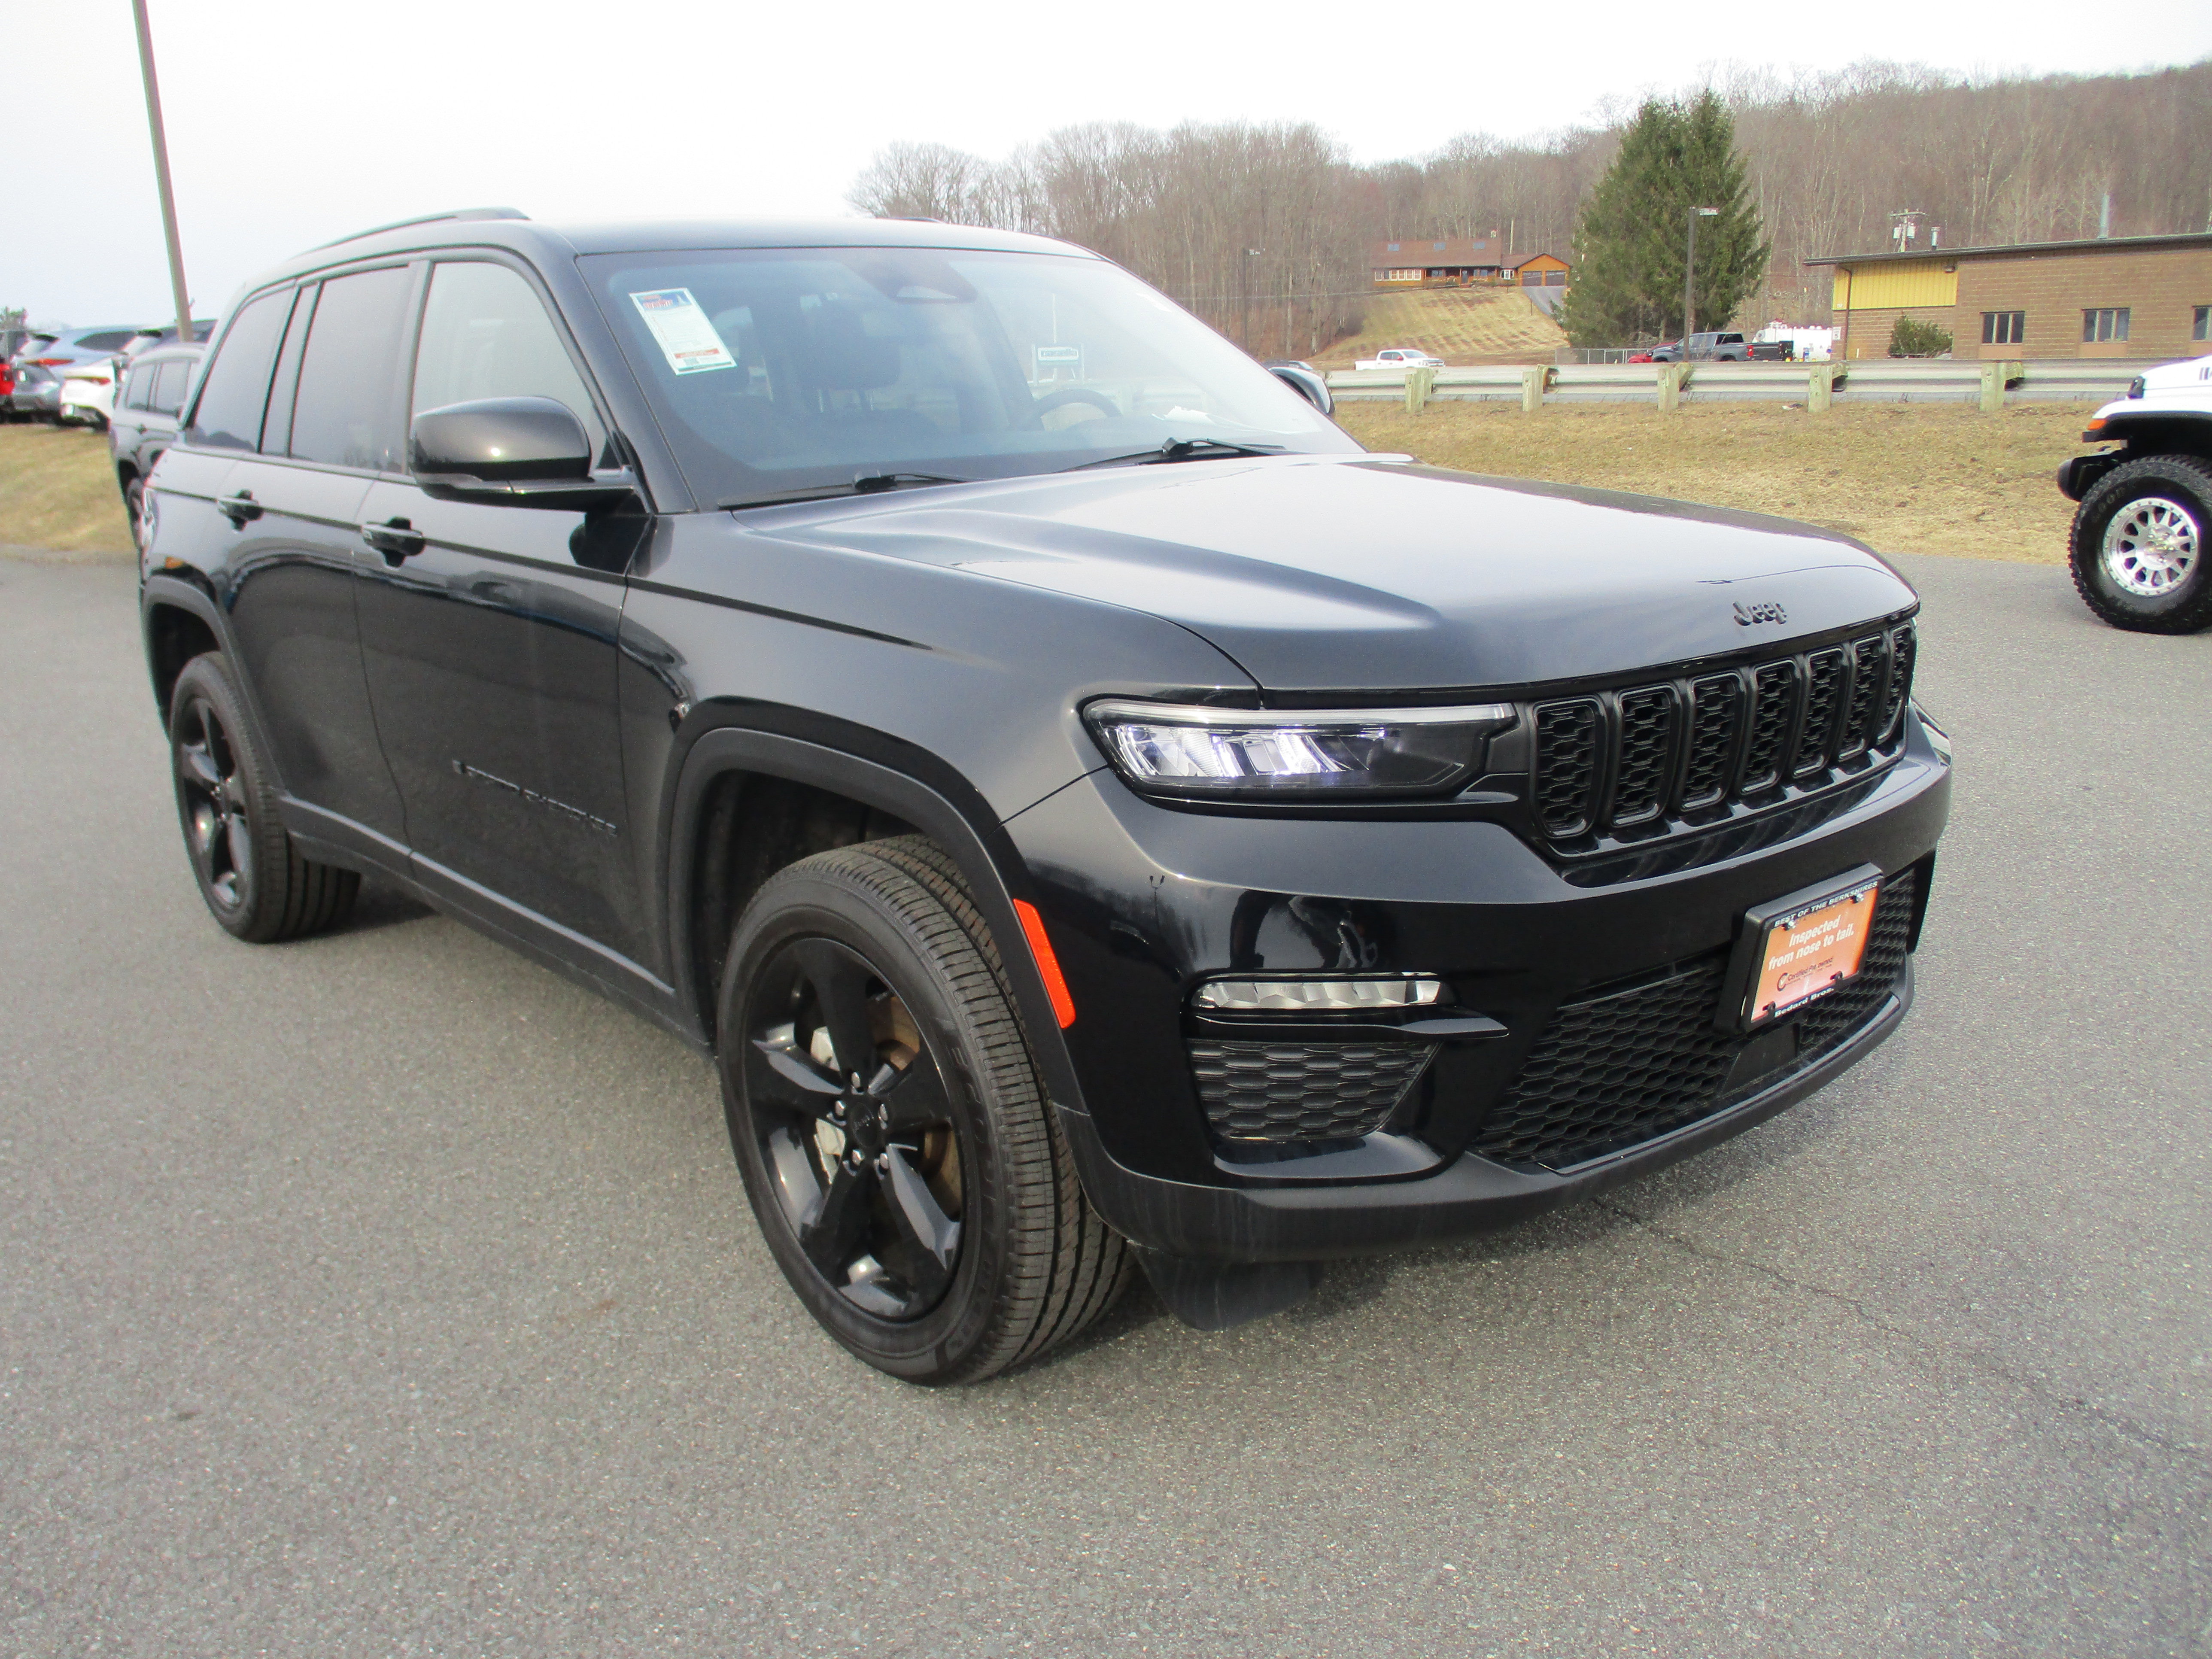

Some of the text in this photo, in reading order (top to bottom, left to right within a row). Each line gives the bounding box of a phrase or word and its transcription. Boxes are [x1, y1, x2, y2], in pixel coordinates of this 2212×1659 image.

[1733, 602, 1787, 626] Jeep
[1774, 881, 1878, 928] BEST OF THE BERKSHIRES
[1768, 923, 1854, 971] from nose to tail.
[1789, 915, 1841, 947] Inspected
[1774, 997, 1809, 1018] Bedard
